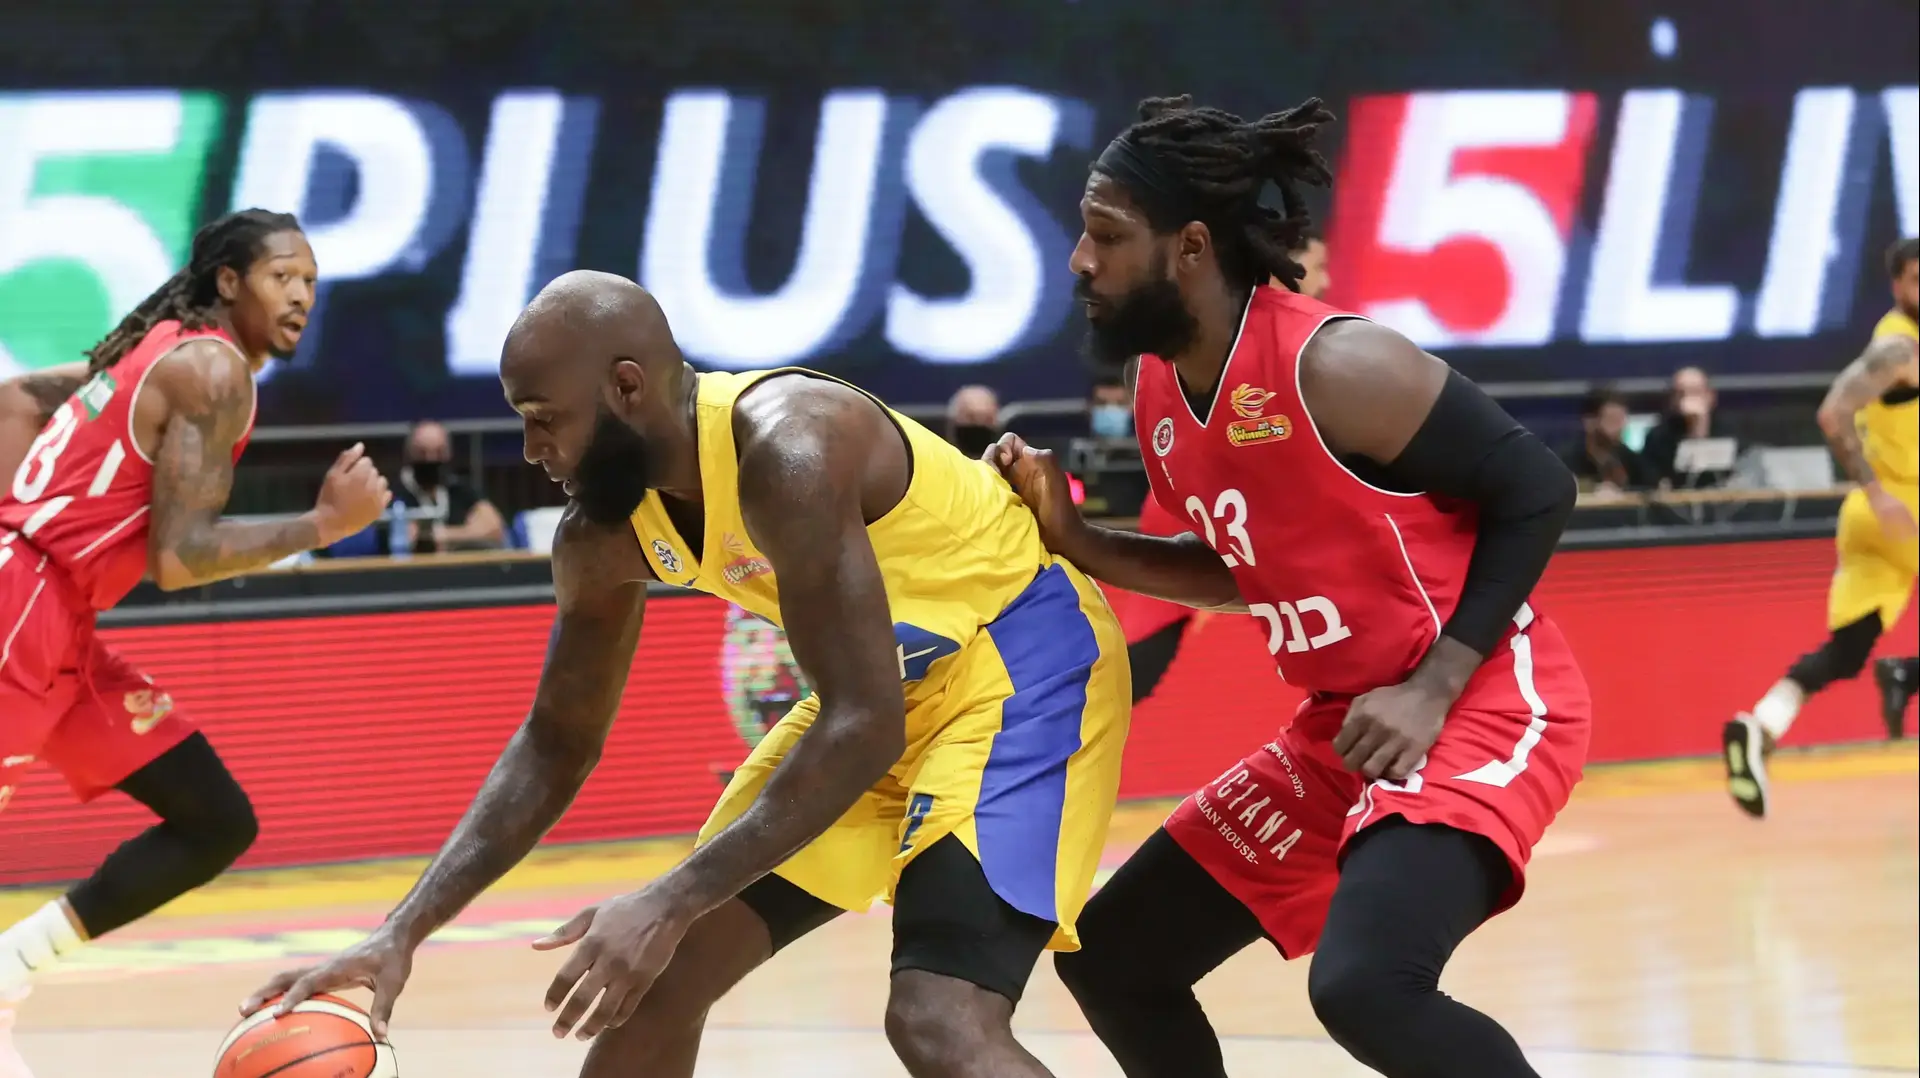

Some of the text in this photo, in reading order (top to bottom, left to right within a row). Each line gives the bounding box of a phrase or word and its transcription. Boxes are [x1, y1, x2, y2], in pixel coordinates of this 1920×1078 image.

[1233, 426, 1271, 443] Winner
[1185, 488, 1256, 568] 23
[1194, 790, 1222, 825] ALIAN
